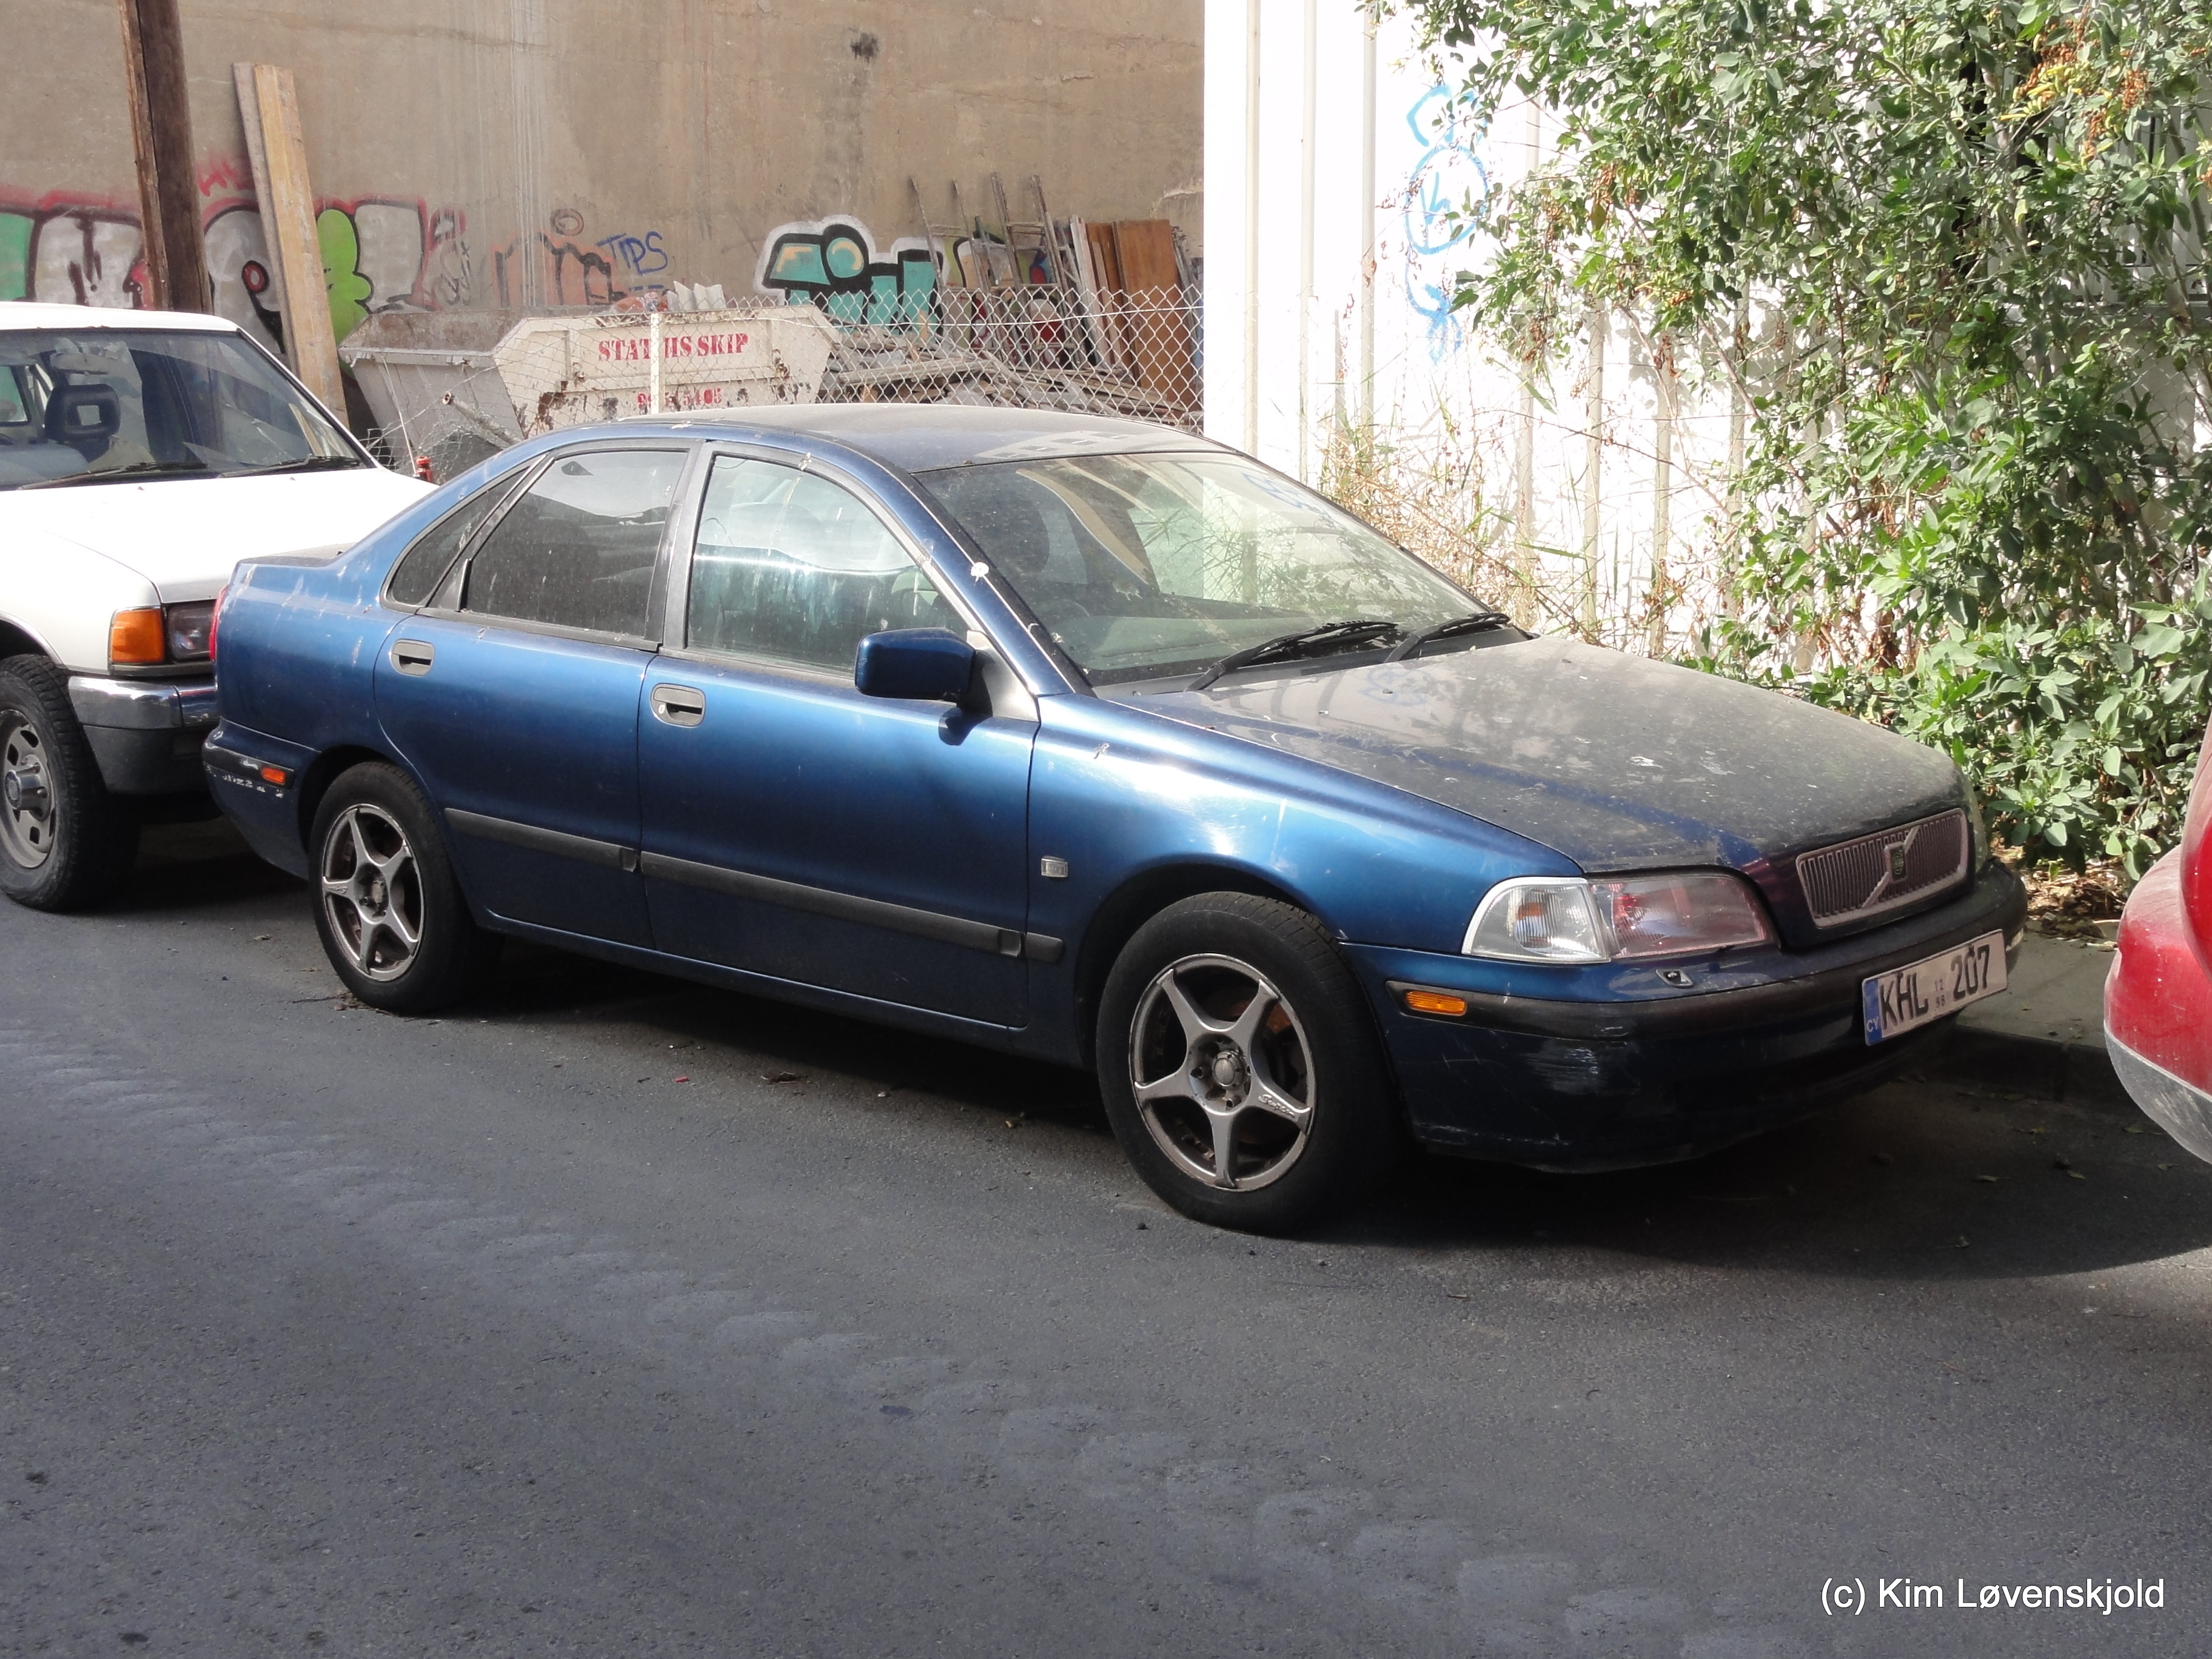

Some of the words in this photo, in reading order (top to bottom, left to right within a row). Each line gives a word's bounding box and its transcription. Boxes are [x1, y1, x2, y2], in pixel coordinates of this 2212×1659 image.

[697, 332, 748, 357] SKIP
[1880, 972, 1929, 1030] KHL
[1950, 944, 1990, 1000] 207
[1866, 1017, 1879, 1032] CY
